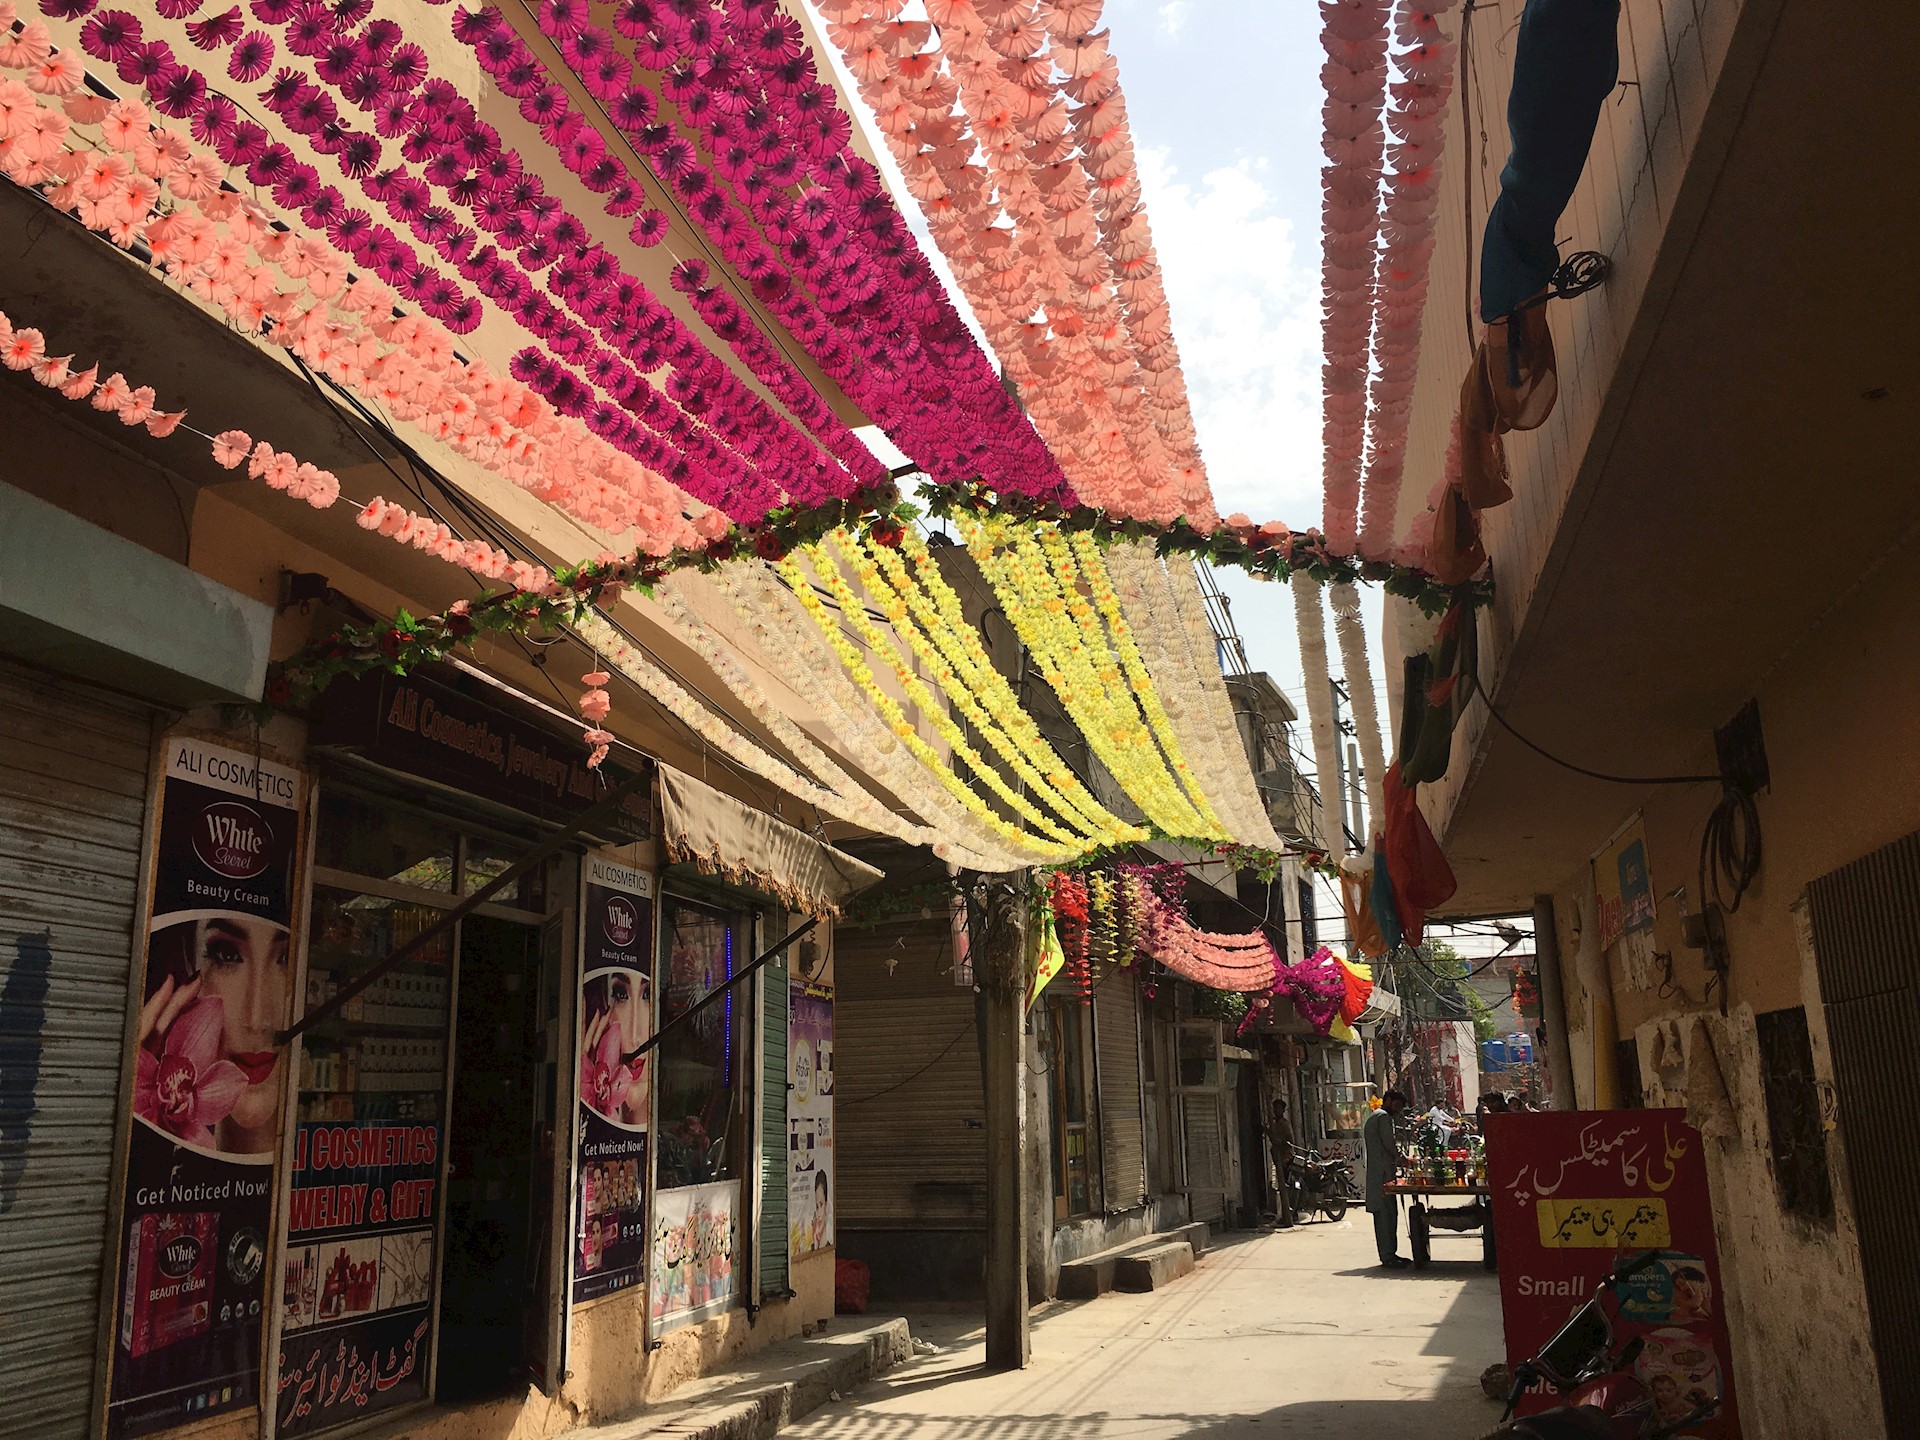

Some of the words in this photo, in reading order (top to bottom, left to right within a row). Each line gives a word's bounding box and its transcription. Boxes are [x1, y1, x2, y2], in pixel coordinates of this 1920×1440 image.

[388, 687, 419, 732] Ali
[177, 748, 202, 774] ALI
[207, 757, 294, 799] COSMETICS
[206, 813, 263, 854] White
[214, 846, 252, 870] Secret
[592, 863, 605, 879] ALI
[606, 866, 647, 891] COSMETICS
[187, 879, 230, 903] Beauty
[234, 888, 270, 906] Cream
[607, 905, 634, 930] White
[601, 948, 620, 963] Beauty
[620, 951, 638, 963] Cream
[312, 1125, 438, 1171] COSMETICS
[584, 1143, 598, 1157] Get
[599, 1139, 627, 1155] Noticed
[627, 1139, 644, 1151] Now!
[1645, 1121, 1688, 1192] علی
[136, 1187, 166, 1206] Get
[171, 1180, 231, 1202] Noticed
[1505, 1164, 1531, 1207] پر
[289, 1183, 369, 1232] WELRY
[370, 1187, 387, 1224] &
[390, 1178, 435, 1222] GIFT
[167, 1245, 196, 1262] White
[150, 1284, 181, 1301] BEAUTY
[181, 1279, 206, 1293] CREAM
[1517, 1275, 1585, 1296] Small
[376, 1317, 429, 1392] گفٹ
[340, 1345, 379, 1407] اینڈ
